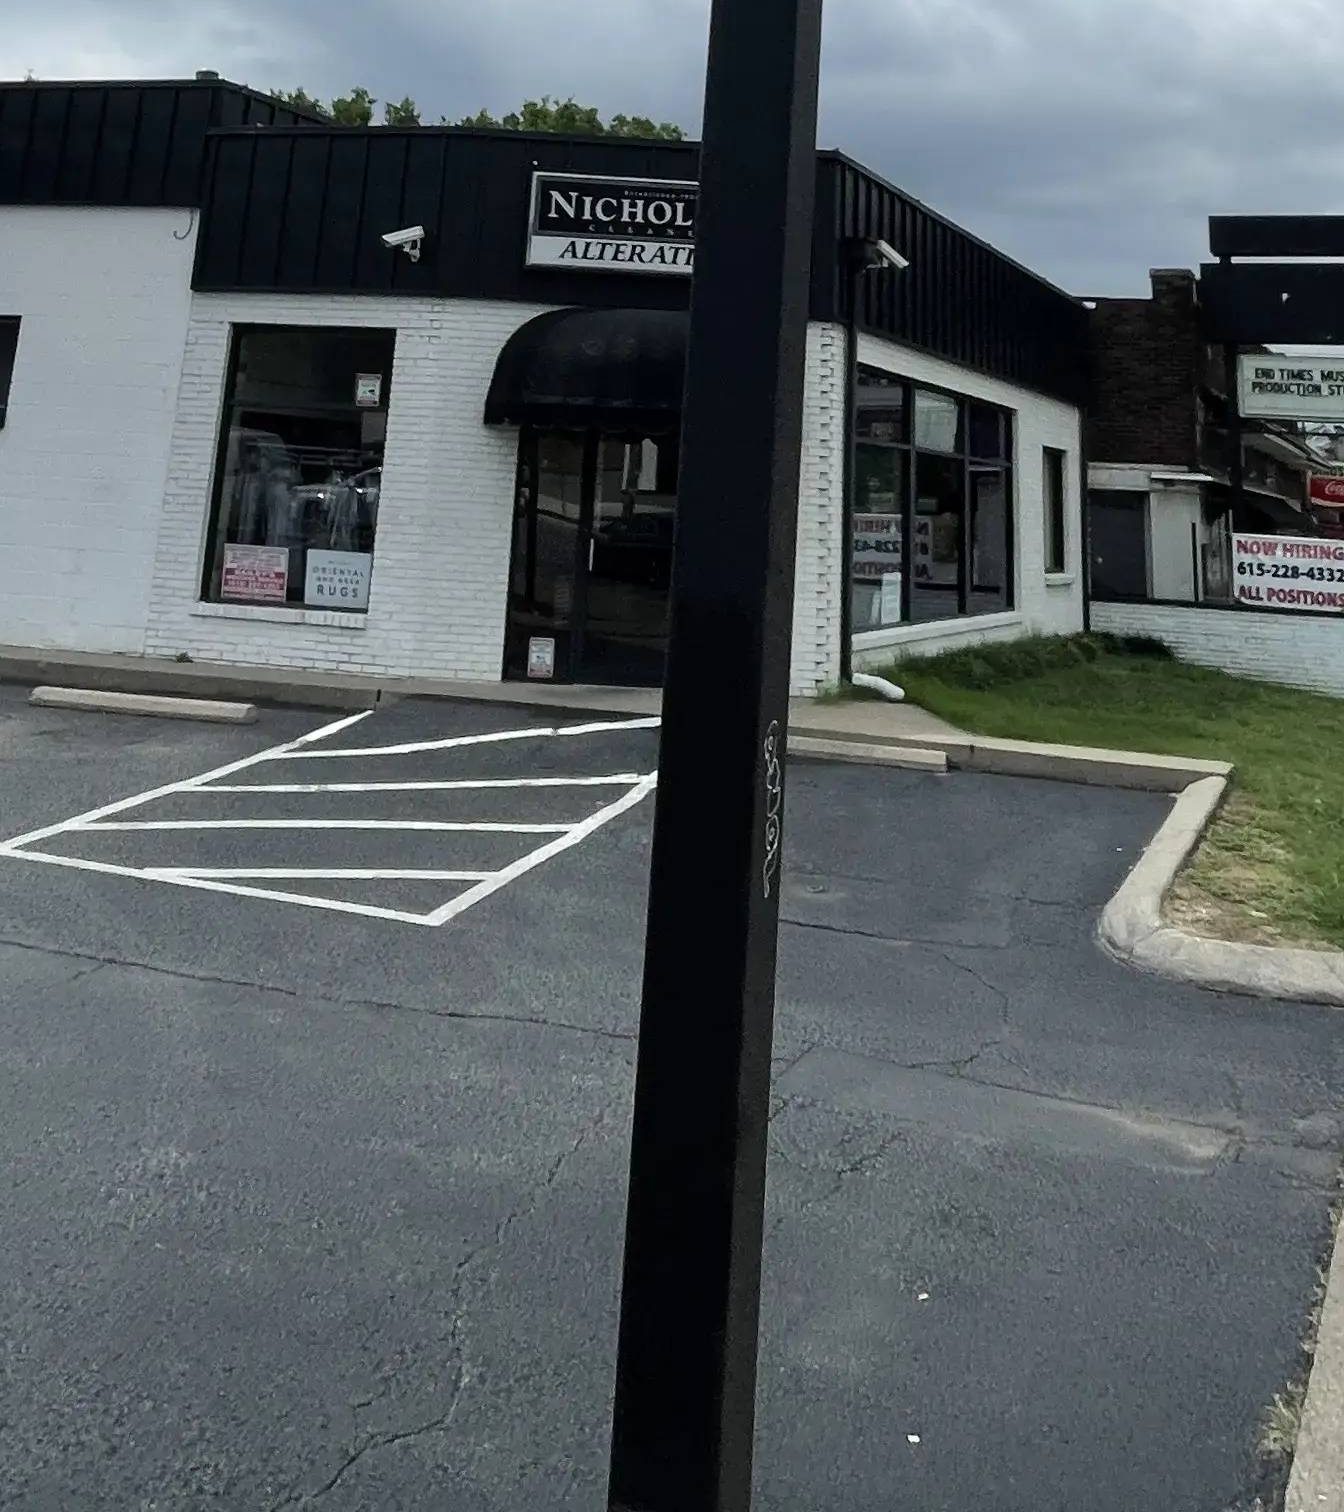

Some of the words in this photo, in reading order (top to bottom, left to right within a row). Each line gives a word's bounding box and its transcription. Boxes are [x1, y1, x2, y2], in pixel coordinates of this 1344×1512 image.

[547, 190, 693, 226] NICHOL
[558, 240, 694, 266] ALTERATI
[1278, 369, 1313, 381] TIMES
[1252, 382, 1322, 396] PRODUCTION
[1236, 540, 1278, 556] NOW
[1282, 543, 1344, 560] HIRING
[317, 584, 359, 598] RUGS
[1238, 585, 1263, 601] ALL
